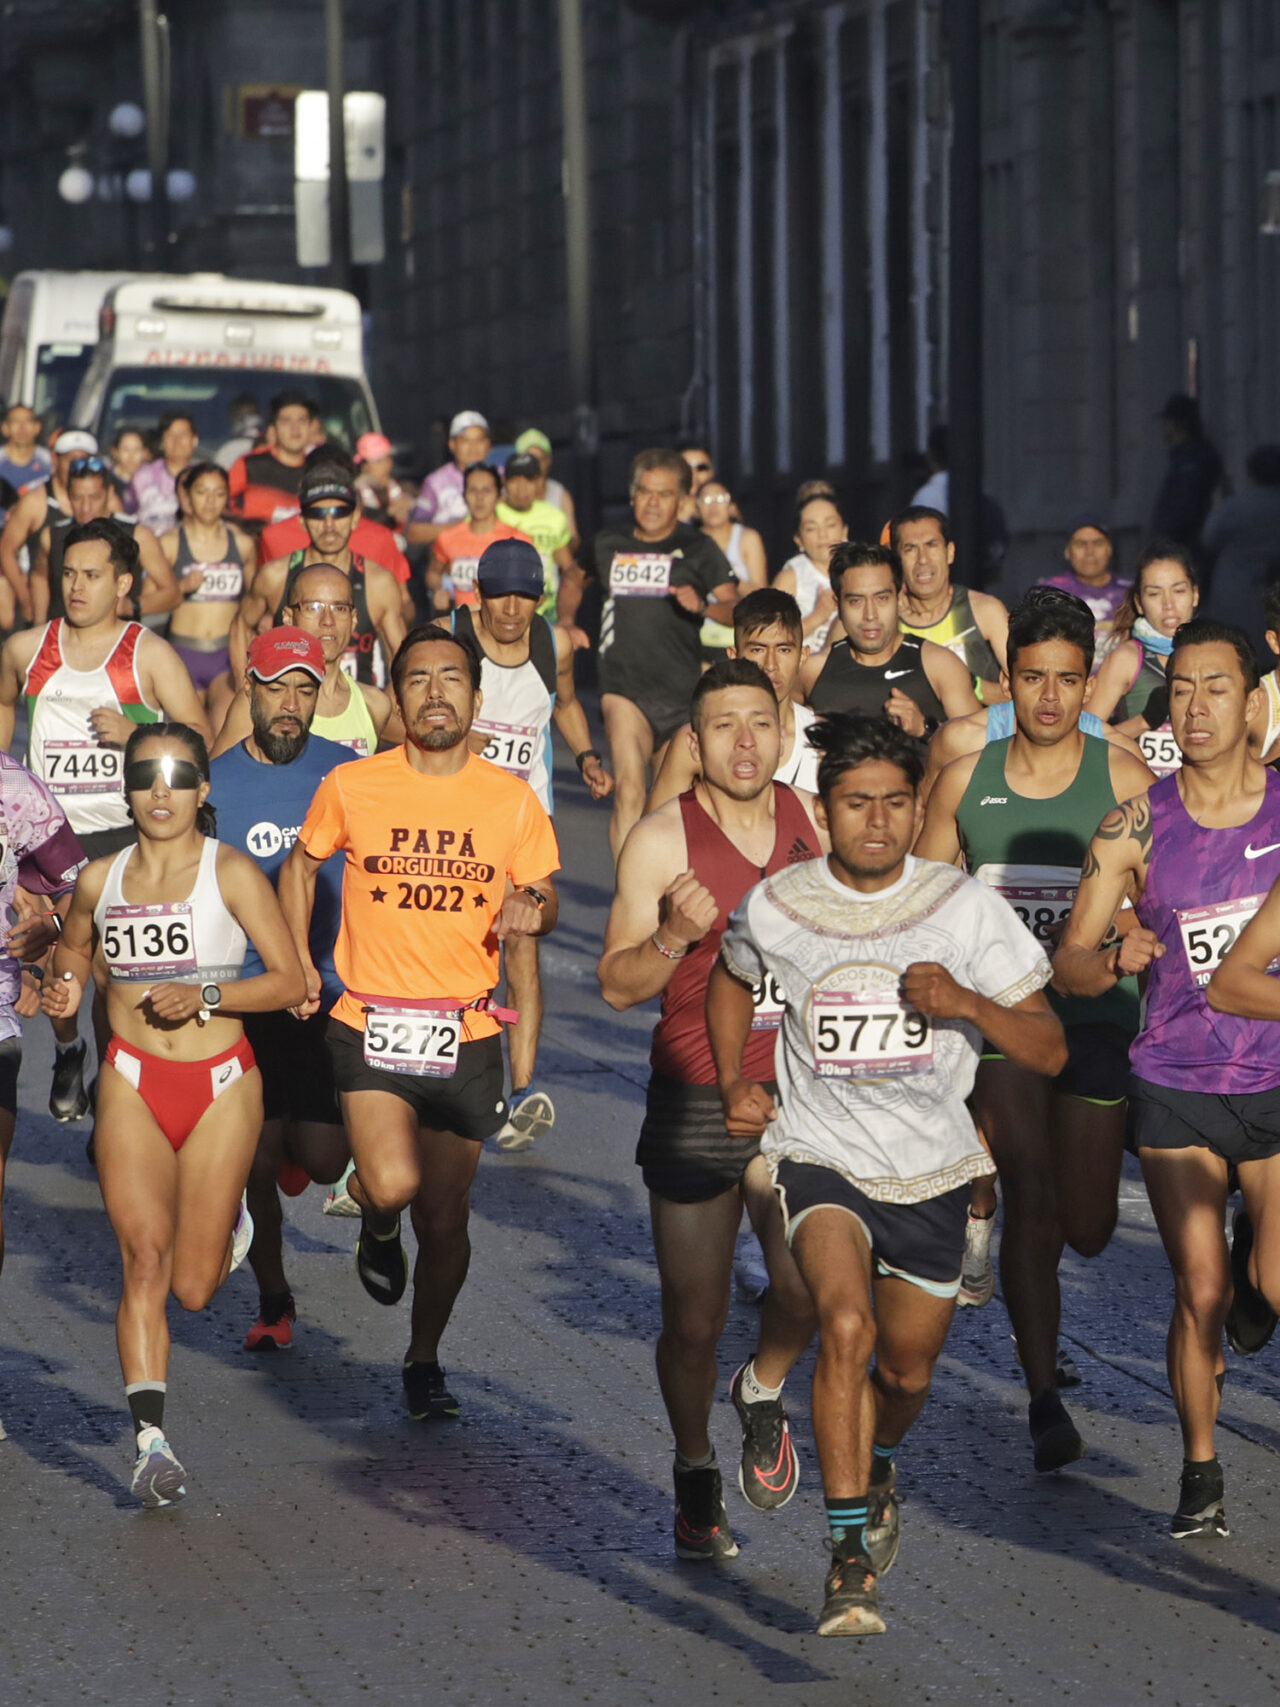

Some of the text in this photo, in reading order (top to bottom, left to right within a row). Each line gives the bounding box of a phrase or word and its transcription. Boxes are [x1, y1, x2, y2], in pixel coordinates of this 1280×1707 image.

[613, 564, 667, 583] 5642
[483, 737, 532, 765] 516
[1142, 736, 1183, 763] 55
[46, 753, 118, 778] 7449
[251, 830, 272, 850] 11
[390, 828, 476, 858] PAPÁ
[377, 856, 489, 882] ORGULLOSO
[787, 851, 815, 863] adidas
[397, 882, 464, 912] 2022
[104, 921, 189, 959] 5136
[1188, 918, 1251, 964] 52
[367, 1022, 457, 1058] 5272
[817, 1011, 928, 1053] 5779
